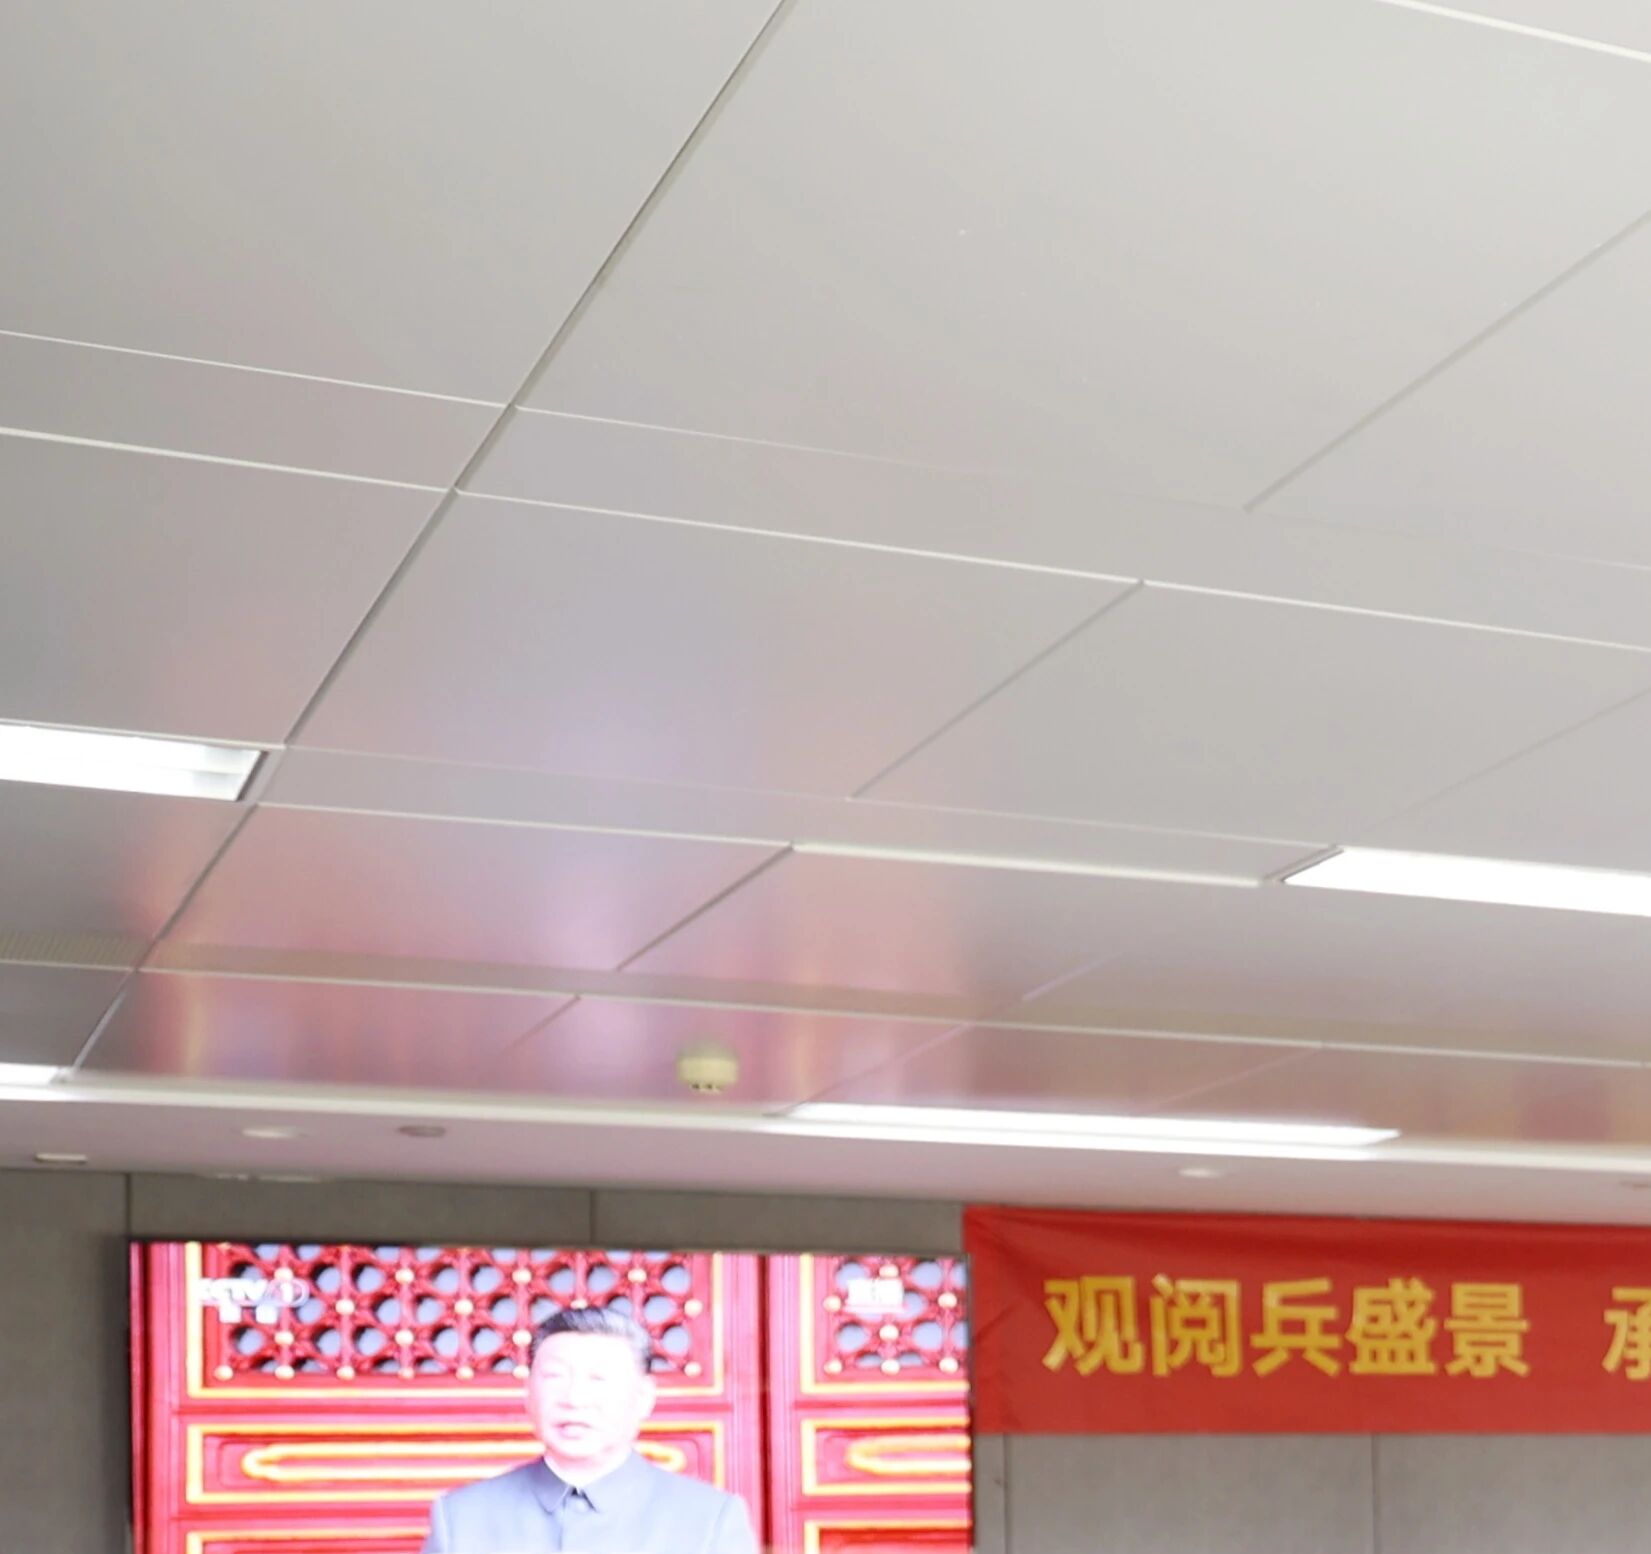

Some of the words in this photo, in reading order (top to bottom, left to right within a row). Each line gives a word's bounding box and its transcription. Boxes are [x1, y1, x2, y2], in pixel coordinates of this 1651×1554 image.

[1043, 1273, 1530, 1378] 观阅兵盛景
